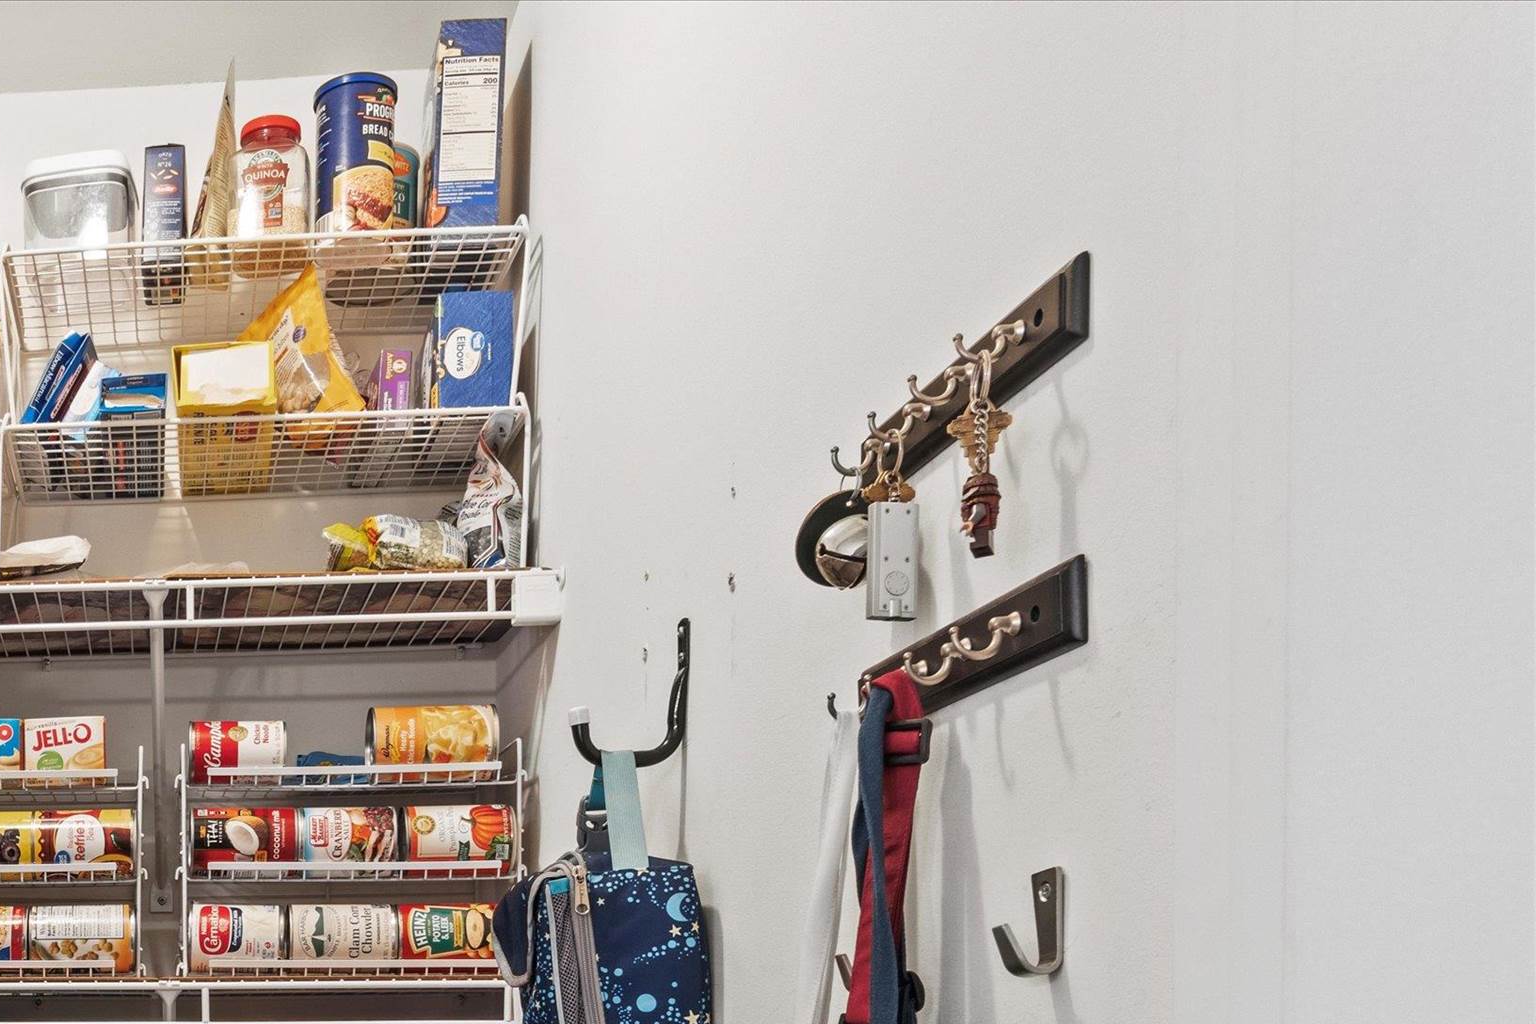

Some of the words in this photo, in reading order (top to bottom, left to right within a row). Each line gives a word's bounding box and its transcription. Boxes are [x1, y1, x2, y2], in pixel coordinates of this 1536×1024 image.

[365, 102, 395, 121] PROGR
[362, 124, 388, 137] BREAD
[244, 169, 286, 183] QUINOA
[456, 336, 466, 372] Elbows
[272, 810, 280, 823] milk
[208, 819, 218, 847] THAI
[361, 907, 373, 954] Chowder
[415, 912, 427, 946] HEINZ
[432, 915, 440, 943] POTATO
[440, 916, 449, 932] LEEK
[349, 930, 360, 959] Clam
